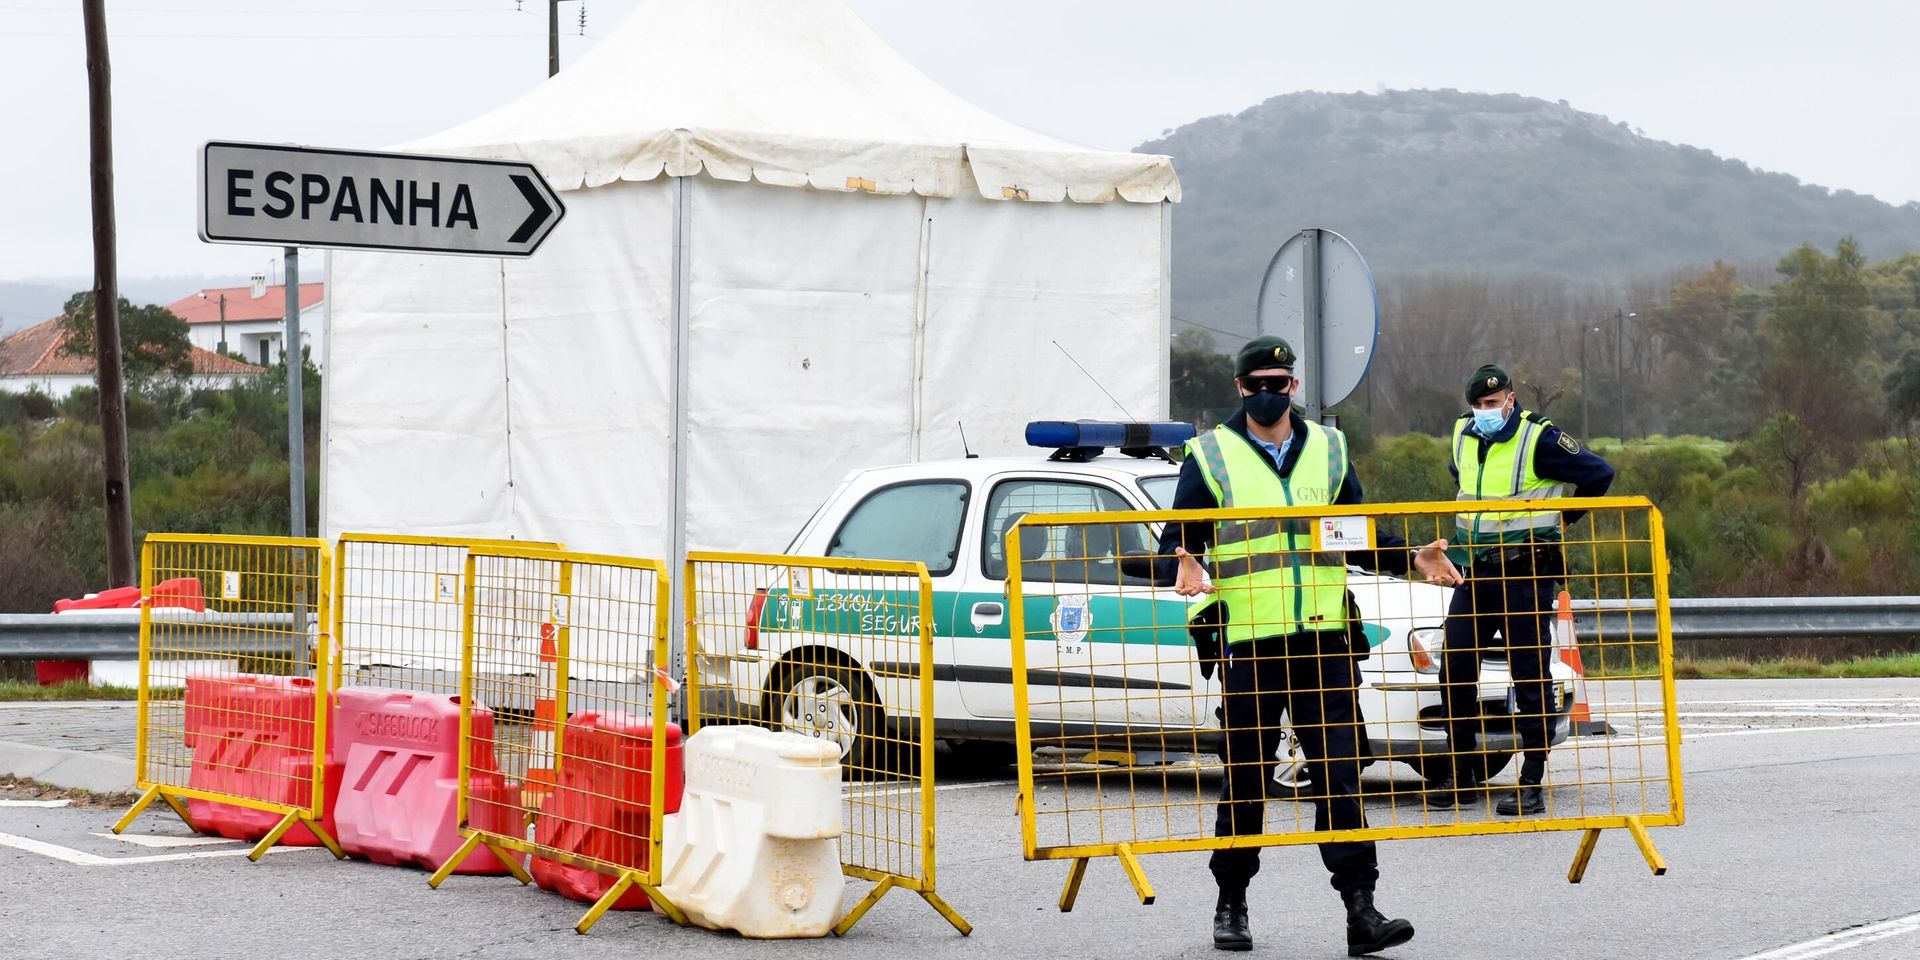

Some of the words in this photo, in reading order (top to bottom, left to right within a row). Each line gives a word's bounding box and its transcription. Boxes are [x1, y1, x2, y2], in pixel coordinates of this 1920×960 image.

[227, 168, 479, 230] ESPANHA
[1296, 486, 1329, 502] GNR
[815, 593, 889, 613] ESCOLA
